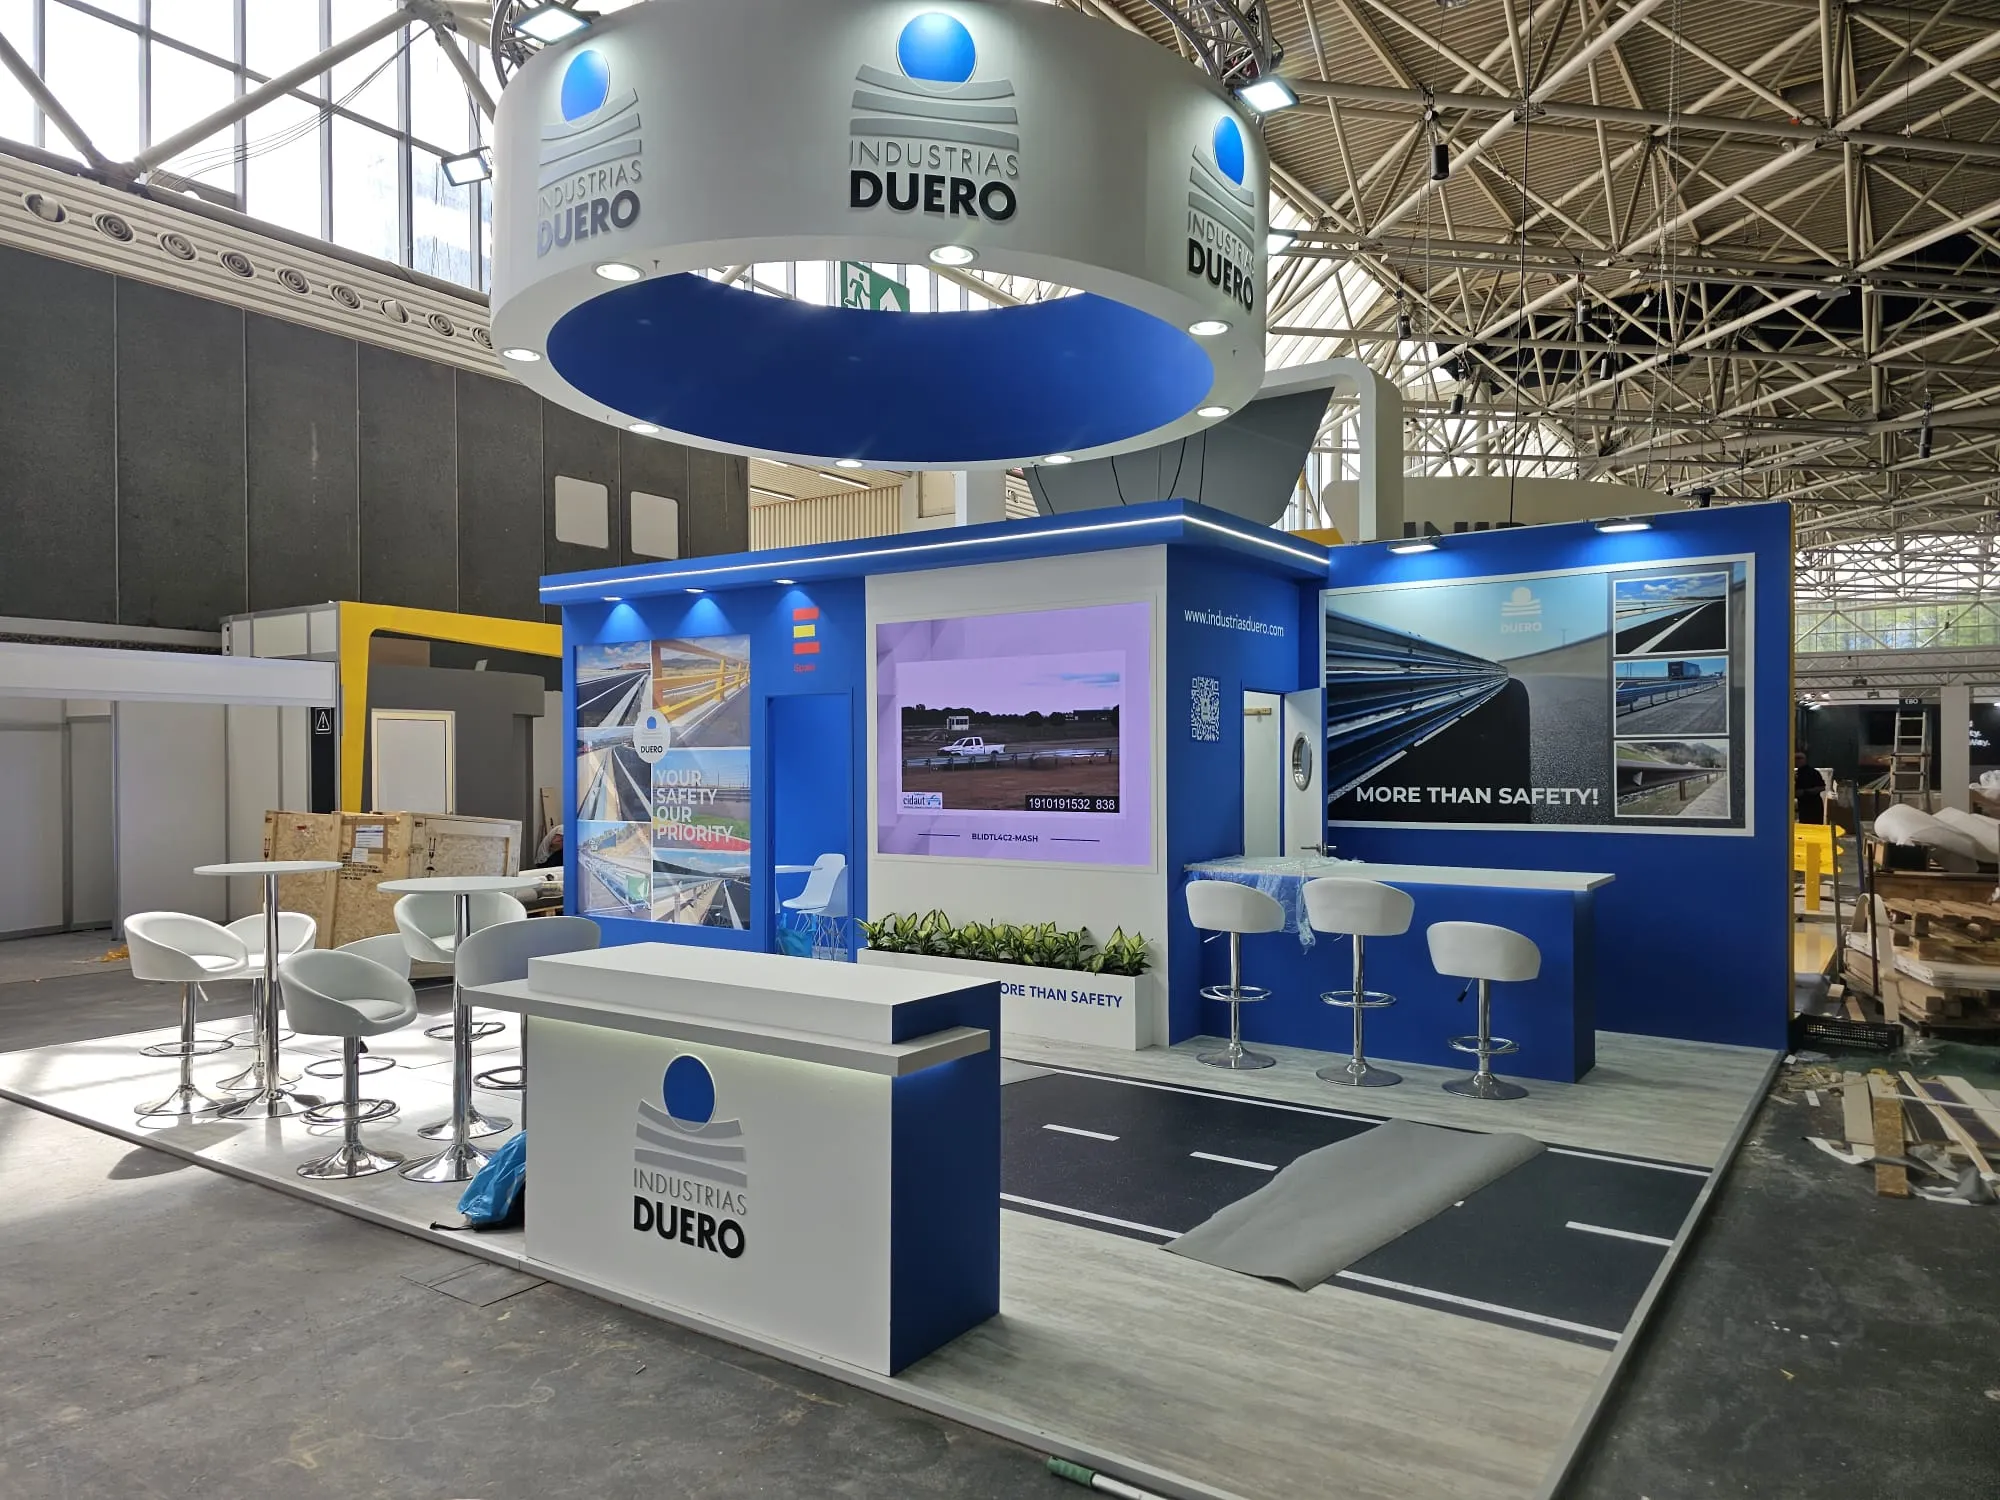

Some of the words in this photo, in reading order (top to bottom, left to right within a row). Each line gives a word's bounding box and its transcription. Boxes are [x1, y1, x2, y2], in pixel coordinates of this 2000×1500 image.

[850, 139, 1018, 179] INDUSTRIAS
[539, 160, 642, 217] INDUSTRIAS
[850, 170, 1017, 221] DUERO
[538, 189, 641, 258] DUERO
[1188, 210, 1255, 278] INDUSTRIAS
[1188, 237, 1254, 312] DUERO
[1184, 609, 1285, 637] www.industriasduero.com
[1501, 621, 1542, 633] DUERO
[640, 745, 663, 753] DUERO
[656, 769, 702, 787] YOUR
[656, 788, 718, 805] SAFETY
[1029, 798, 1090, 810] 1910191532
[1095, 799, 1115, 810] 838
[1356, 786, 1421, 802] MORE
[1427, 787, 1492, 803] THAN
[1498, 787, 1599, 806] SAFETY!
[656, 805, 692, 822] OUR
[656, 824, 734, 843] PRIORITY
[1000, 982, 1026, 996] ORE
[1029, 985, 1067, 1002] THAN
[1071, 990, 1122, 1008] SAFETY
[633, 1167, 746, 1216] INDUSTRIAS
[633, 1195, 745, 1259] DUERO
